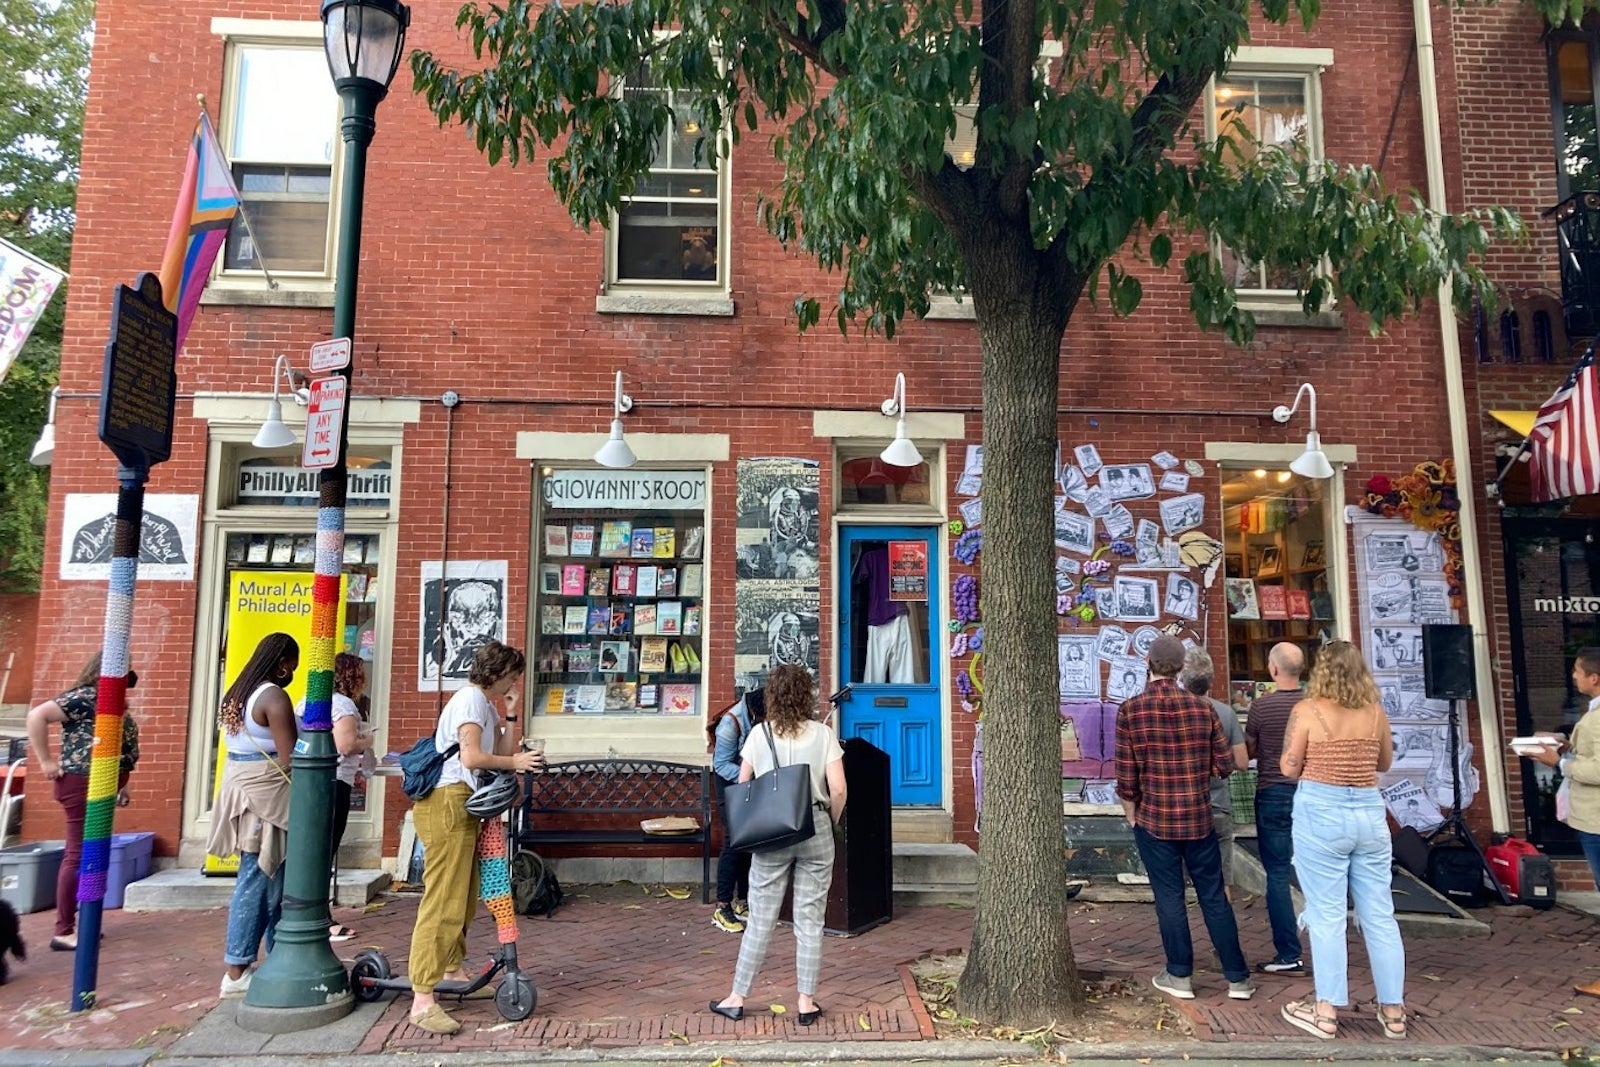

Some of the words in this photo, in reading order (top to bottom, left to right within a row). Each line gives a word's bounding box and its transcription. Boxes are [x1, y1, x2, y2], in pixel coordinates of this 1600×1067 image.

[0, 266, 40, 349] EDOM
[311, 390, 320, 405] NO
[321, 388, 343, 400] PARKING
[316, 414, 332, 428] ANY
[314, 430, 331, 444] TIME
[240, 471, 321, 493] PhillyAI
[239, 581, 287, 596] Mural
[290, 582, 313, 597] Ar
[237, 598, 312, 616] Philadelp
[1534, 596, 1600, 612] mixto
[1389, 788, 1422, 802] Drum
